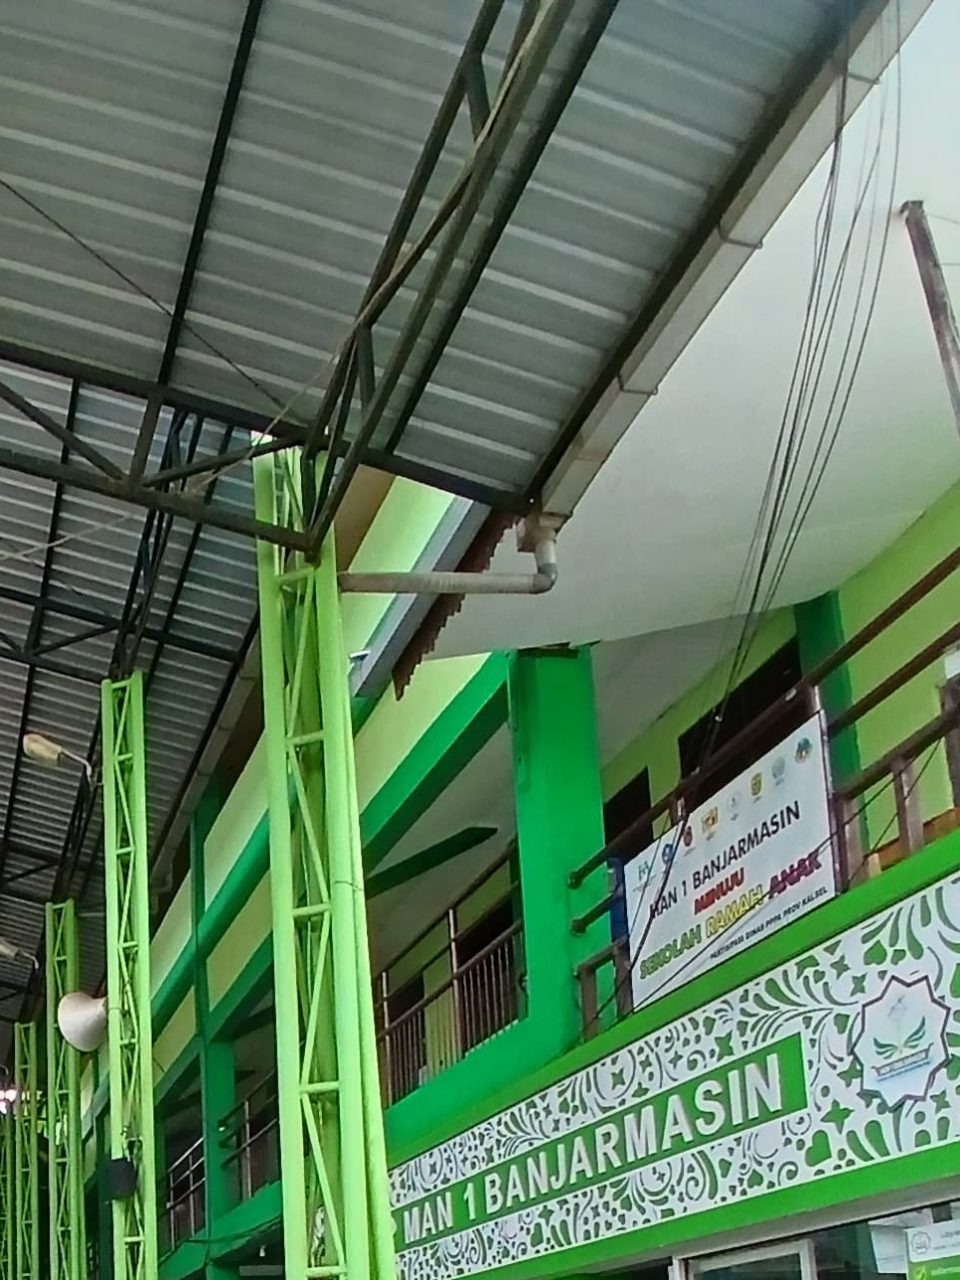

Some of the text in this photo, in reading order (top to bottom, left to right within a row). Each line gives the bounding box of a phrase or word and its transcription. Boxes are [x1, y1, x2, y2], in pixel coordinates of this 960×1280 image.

[682, 881, 687, 896] 1
[693, 801, 800, 889] BANJARMASIN
[640, 924, 701, 979] SEKOLAH
[403, 1051, 783, 1242] MAN 1 BANJARMASIN
